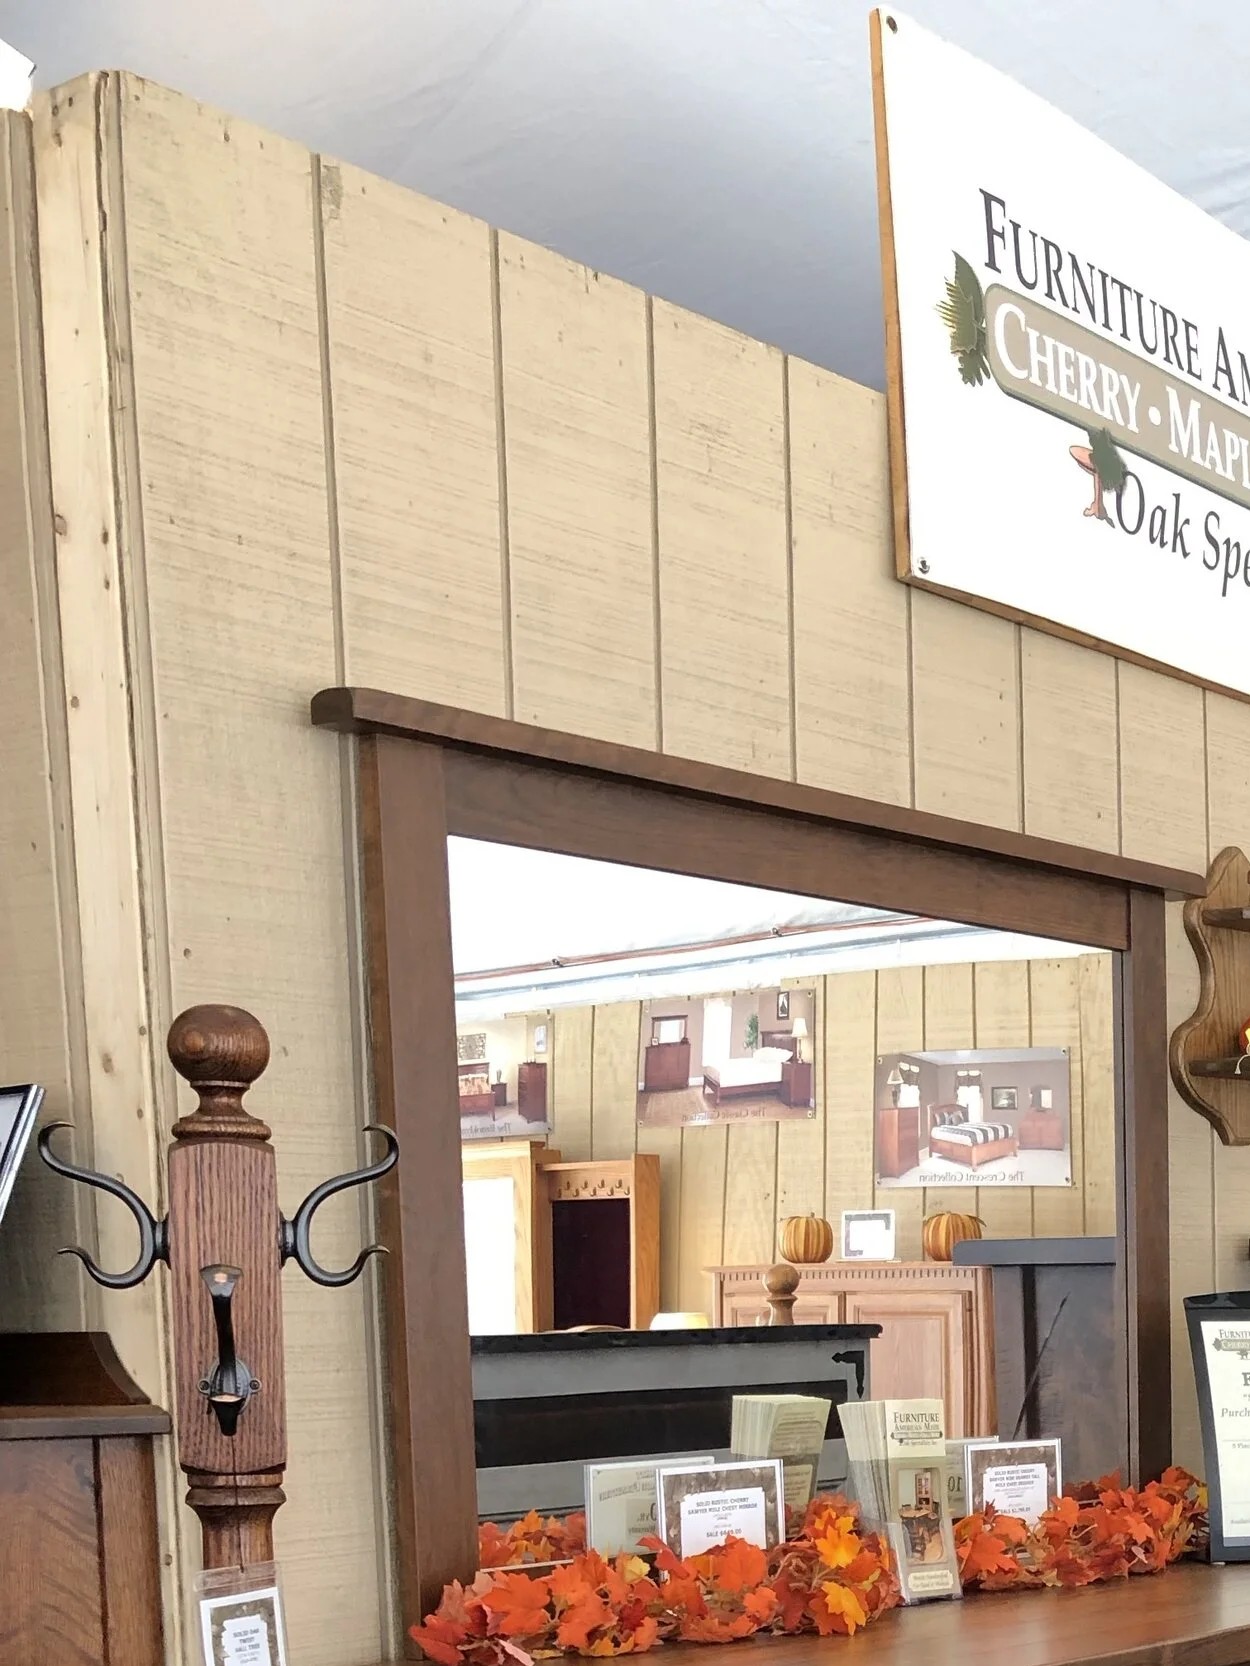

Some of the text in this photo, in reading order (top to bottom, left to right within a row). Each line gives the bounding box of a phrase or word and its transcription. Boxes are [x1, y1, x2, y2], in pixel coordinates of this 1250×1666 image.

[979, 188, 1202, 381] FURNITURE
[994, 303, 1141, 434] CHERRY
[1116, 471, 1191, 559] Oak
[894, 1411, 939, 1423] FURNITURE
